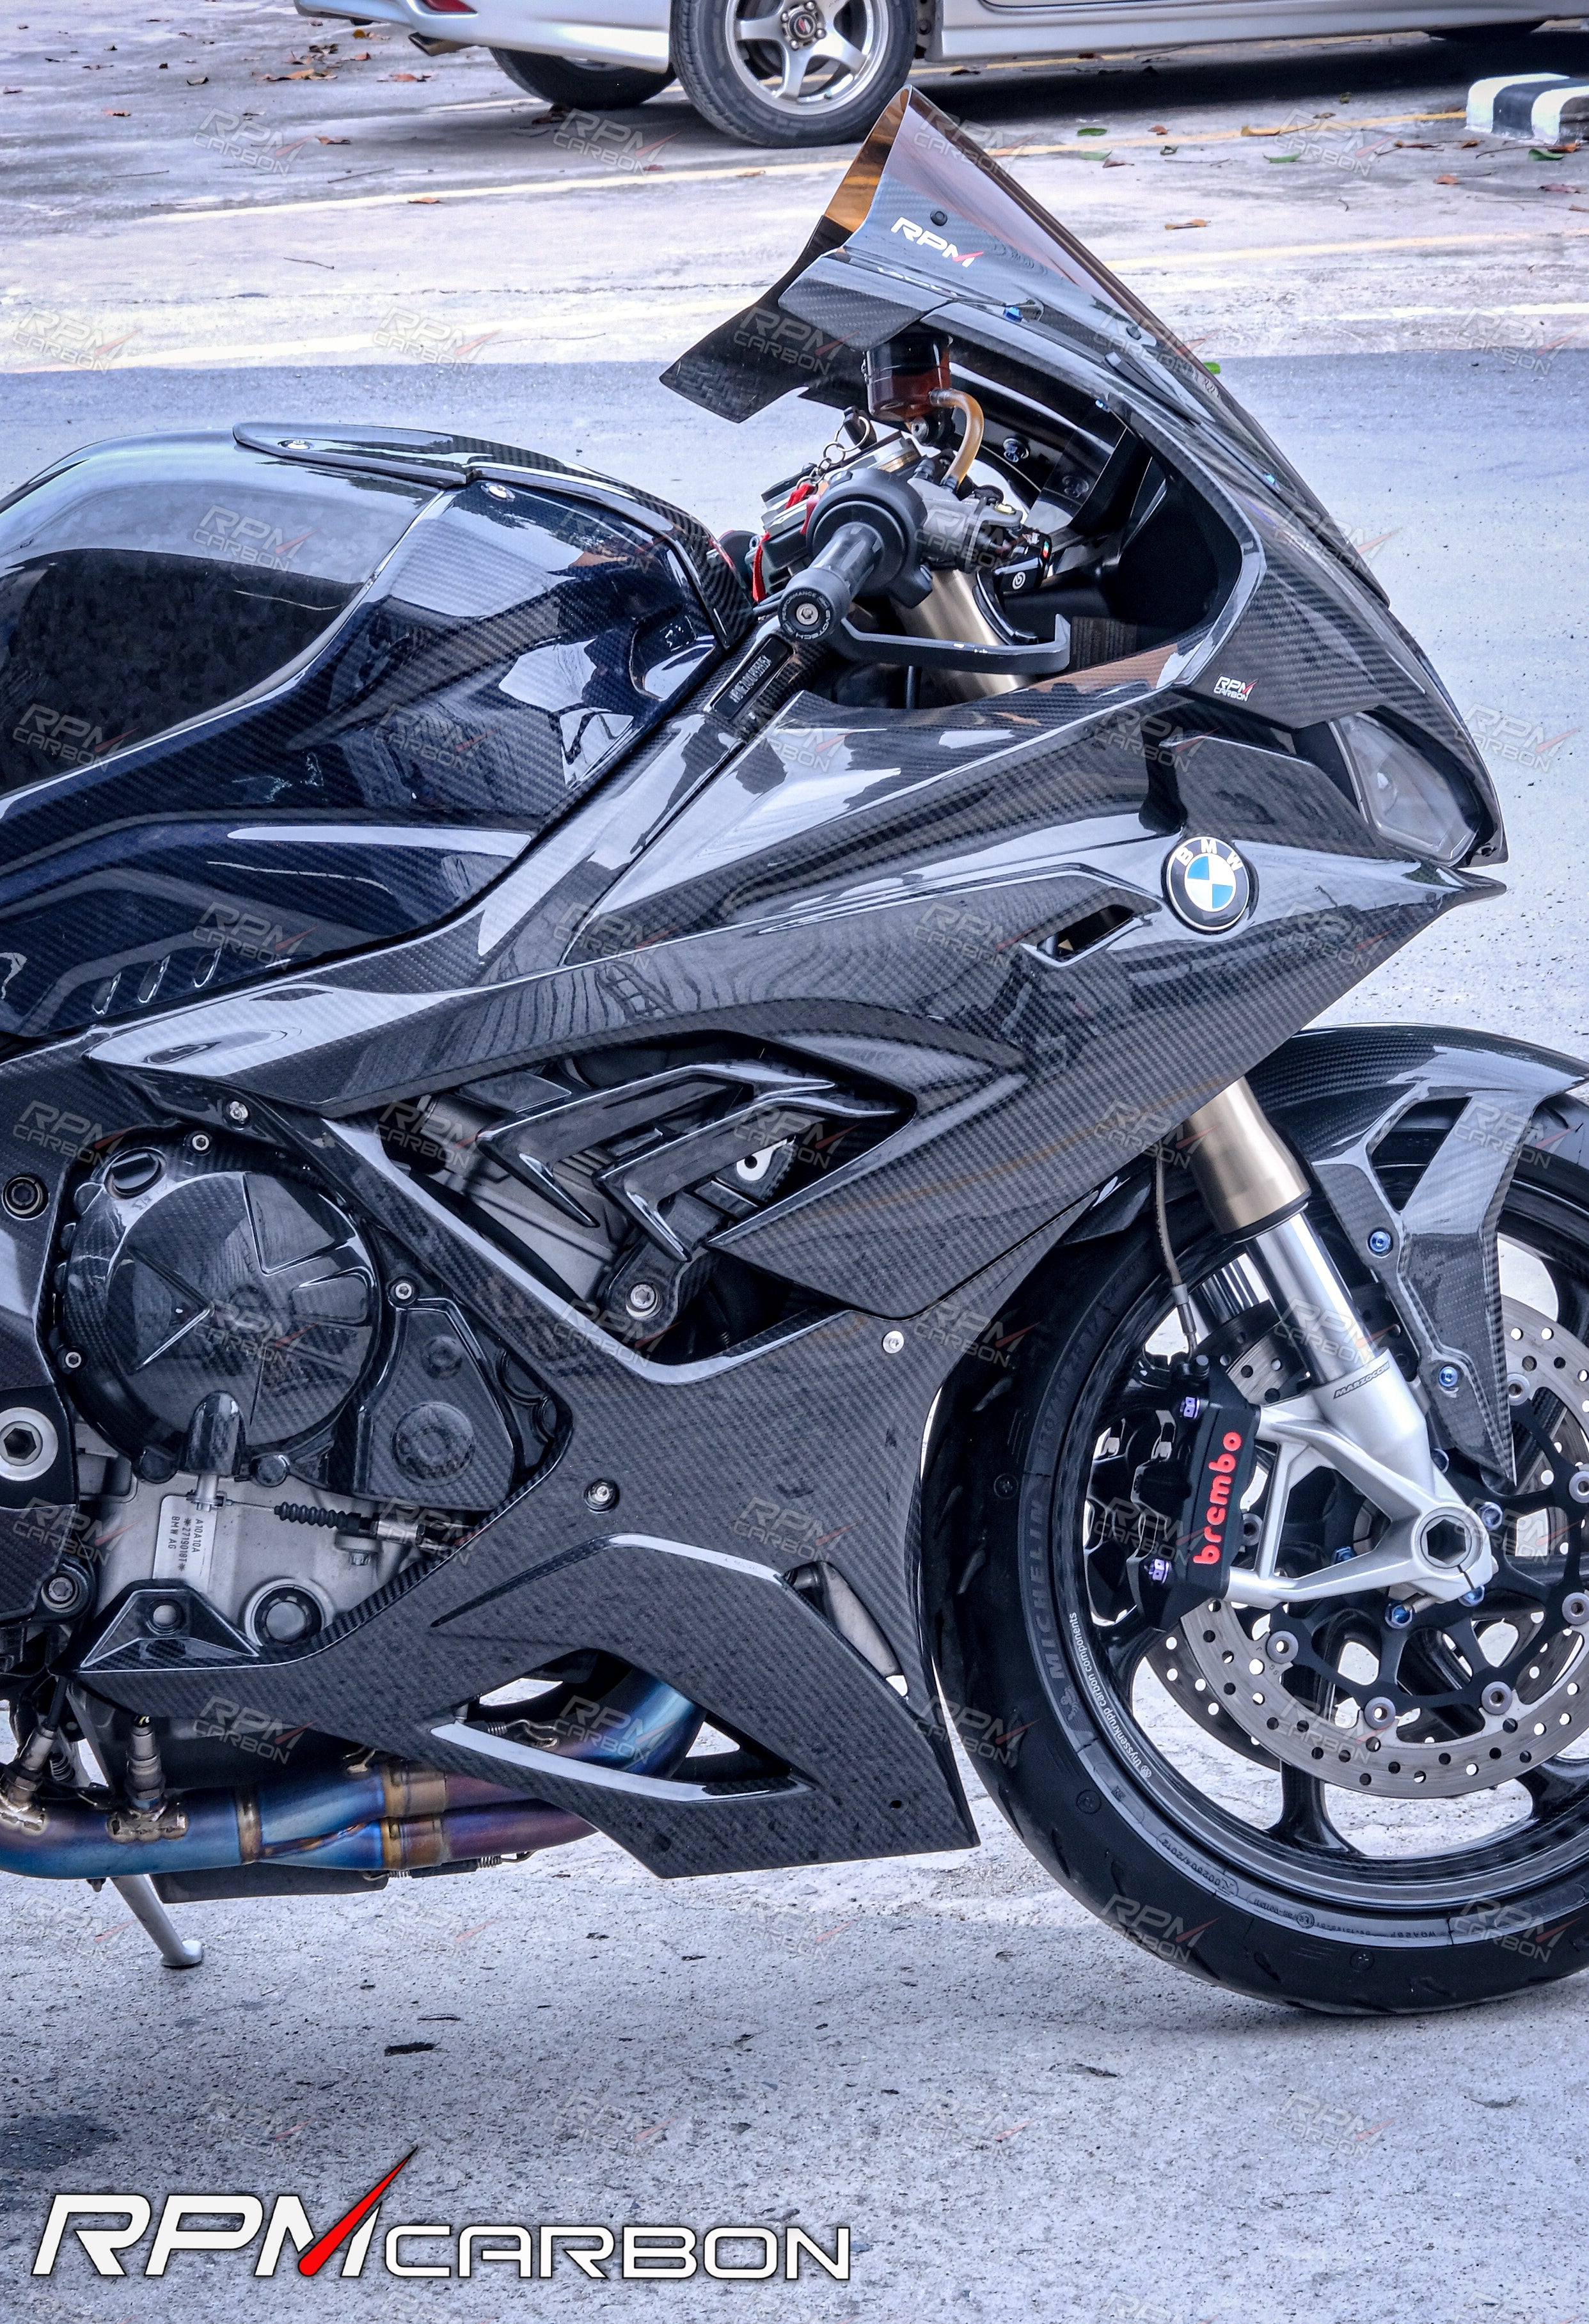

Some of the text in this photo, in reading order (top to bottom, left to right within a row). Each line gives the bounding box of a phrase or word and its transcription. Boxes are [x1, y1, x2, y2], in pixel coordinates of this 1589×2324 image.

[890, 216, 984, 268] RPM
[1213, 687, 1249, 702] CARBON
[1215, 676, 1258, 696] RPM
[1176, 838, 1244, 871] BMW
[1192, 1431, 1242, 1565] brembo
[168, 1516, 181, 1549] BMW AG
[191, 1518, 205, 1553] A10A10A
[1029, 1499, 1065, 1680] MICHELIN
[1069, 1612, 1093, 1673] components
[1087, 1673, 1107, 1707] carbon
[1103, 1707, 1142, 1768] thyssenkrupp
